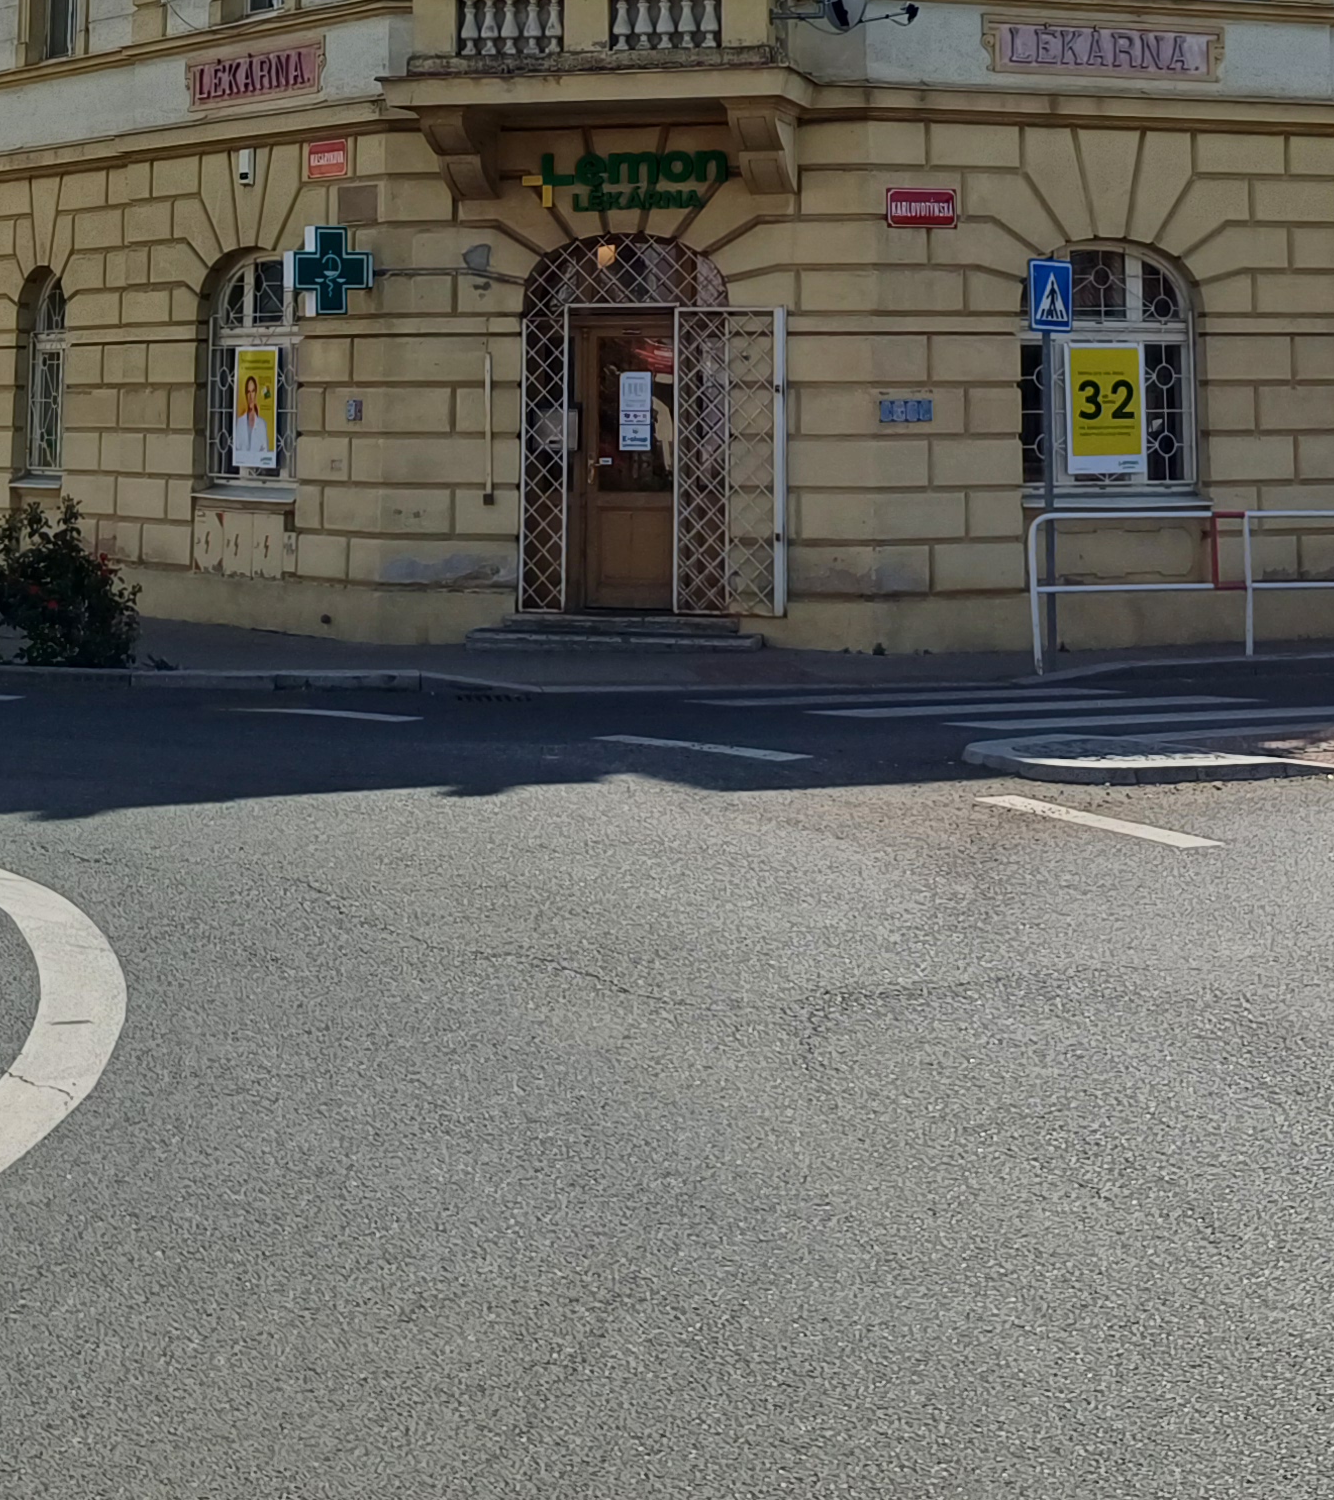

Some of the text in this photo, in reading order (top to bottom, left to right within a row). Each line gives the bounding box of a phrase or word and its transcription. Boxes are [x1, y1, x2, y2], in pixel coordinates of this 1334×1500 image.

[541, 150, 728, 187] Lemon
[573, 185, 703, 212] LÉKÁRNA
[891, 197, 954, 217] KARLOVOTÝNSKÁ
[1078, 379, 1135, 420] 3 2
